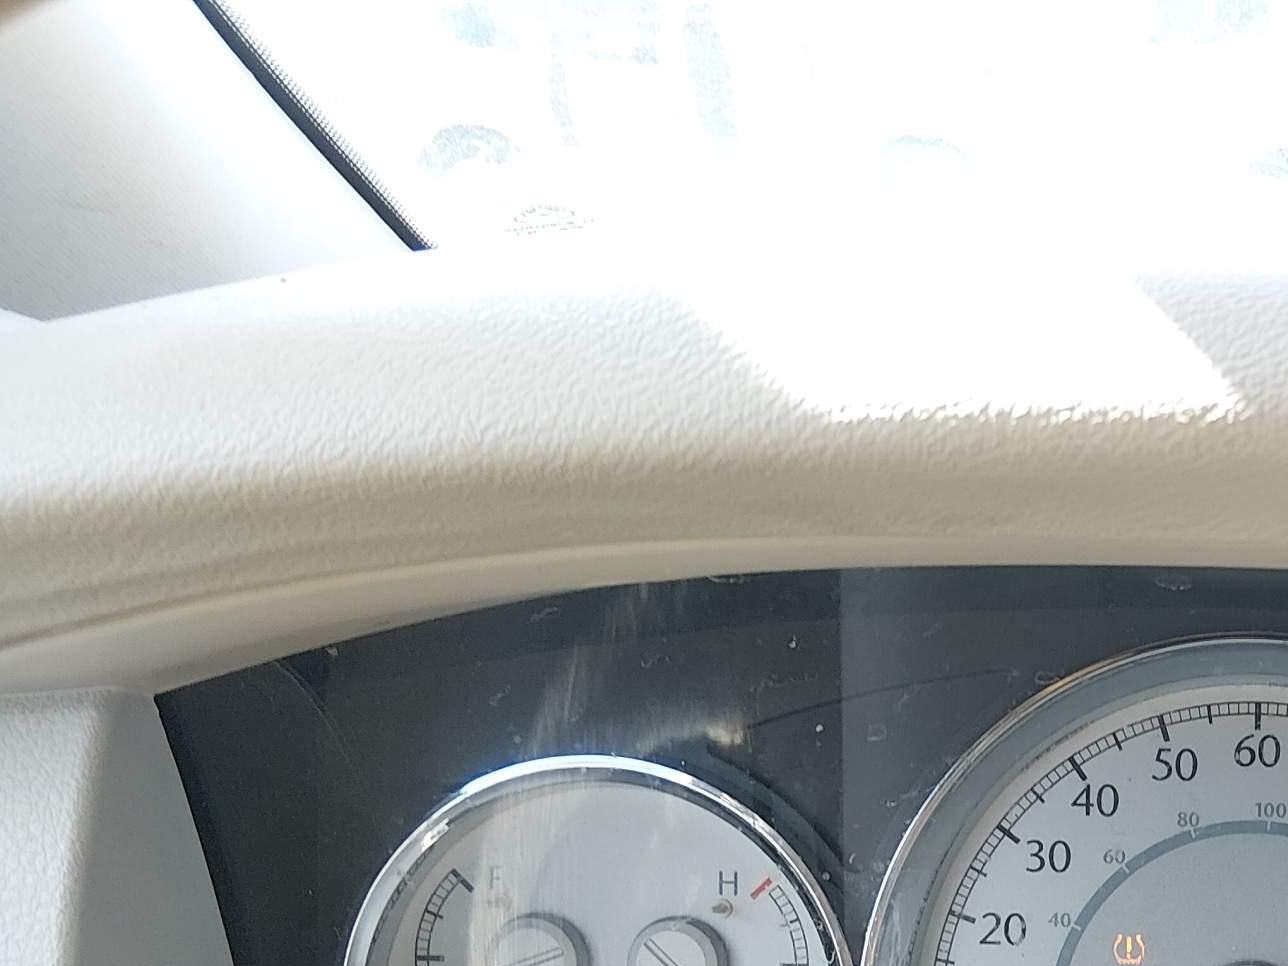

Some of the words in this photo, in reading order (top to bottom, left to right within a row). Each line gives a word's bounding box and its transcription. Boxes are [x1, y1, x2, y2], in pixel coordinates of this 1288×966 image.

[1151, 748, 1198, 782] 50
[1234, 734, 1281, 768] 60
[1072, 783, 1119, 817] 40
[1255, 802, 1286, 818] 100
[1177, 811, 1200, 828] 80
[1026, 840, 1071, 873] 30
[1103, 849, 1126, 865] 60
[718, 871, 738, 896] H
[979, 913, 1026, 946] 20
[1048, 912, 1072, 929] 40
